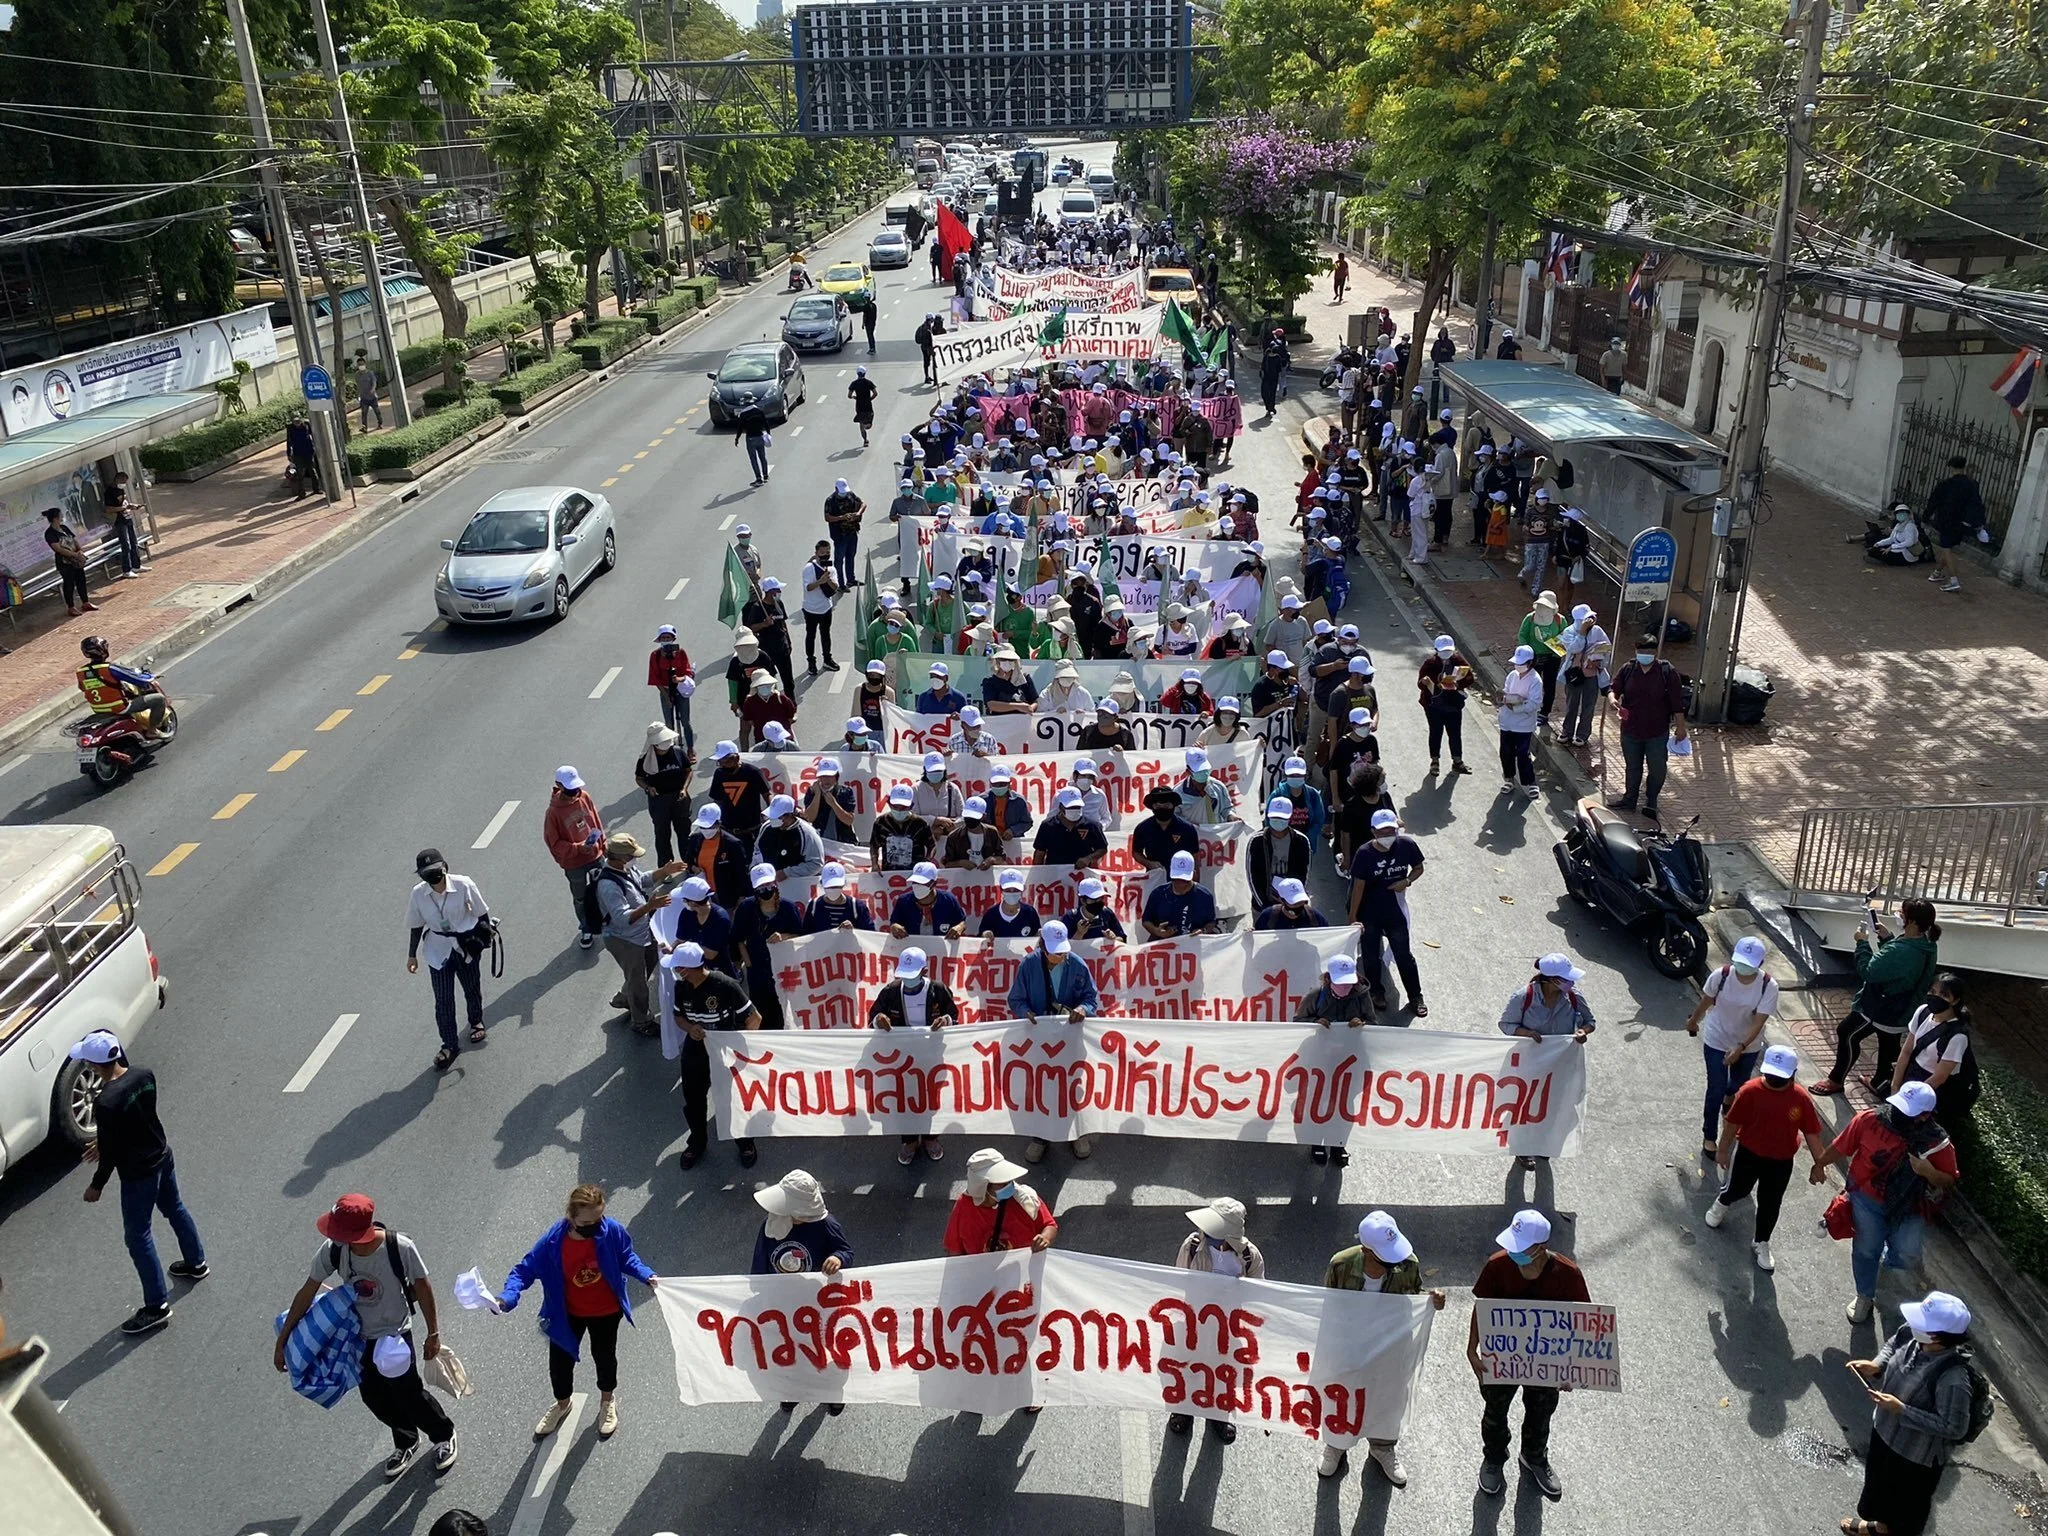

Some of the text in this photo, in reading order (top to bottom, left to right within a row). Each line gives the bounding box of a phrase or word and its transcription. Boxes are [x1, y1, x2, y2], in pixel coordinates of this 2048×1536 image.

[83, 351, 177, 383] ASIA PACIFIC INTERNATIONAL UNIVERSITY
[91, 689, 102, 702] 3
[731, 1031, 1552, 1146] พัฒนาสังคมได้ต้องให้ประชาชนรวมกลุ่ม
[698, 1281, 1263, 1374] ทวงคืนเสรีภาพการ
[1491, 1307, 1615, 1340] การรวมกลุ่ม
[1485, 1328, 1613, 1360] ของ ประชาชน
[1537, 1357, 1620, 1388] อาชญากร
[1158, 1352, 1366, 1441] รวมกลุ่ม
